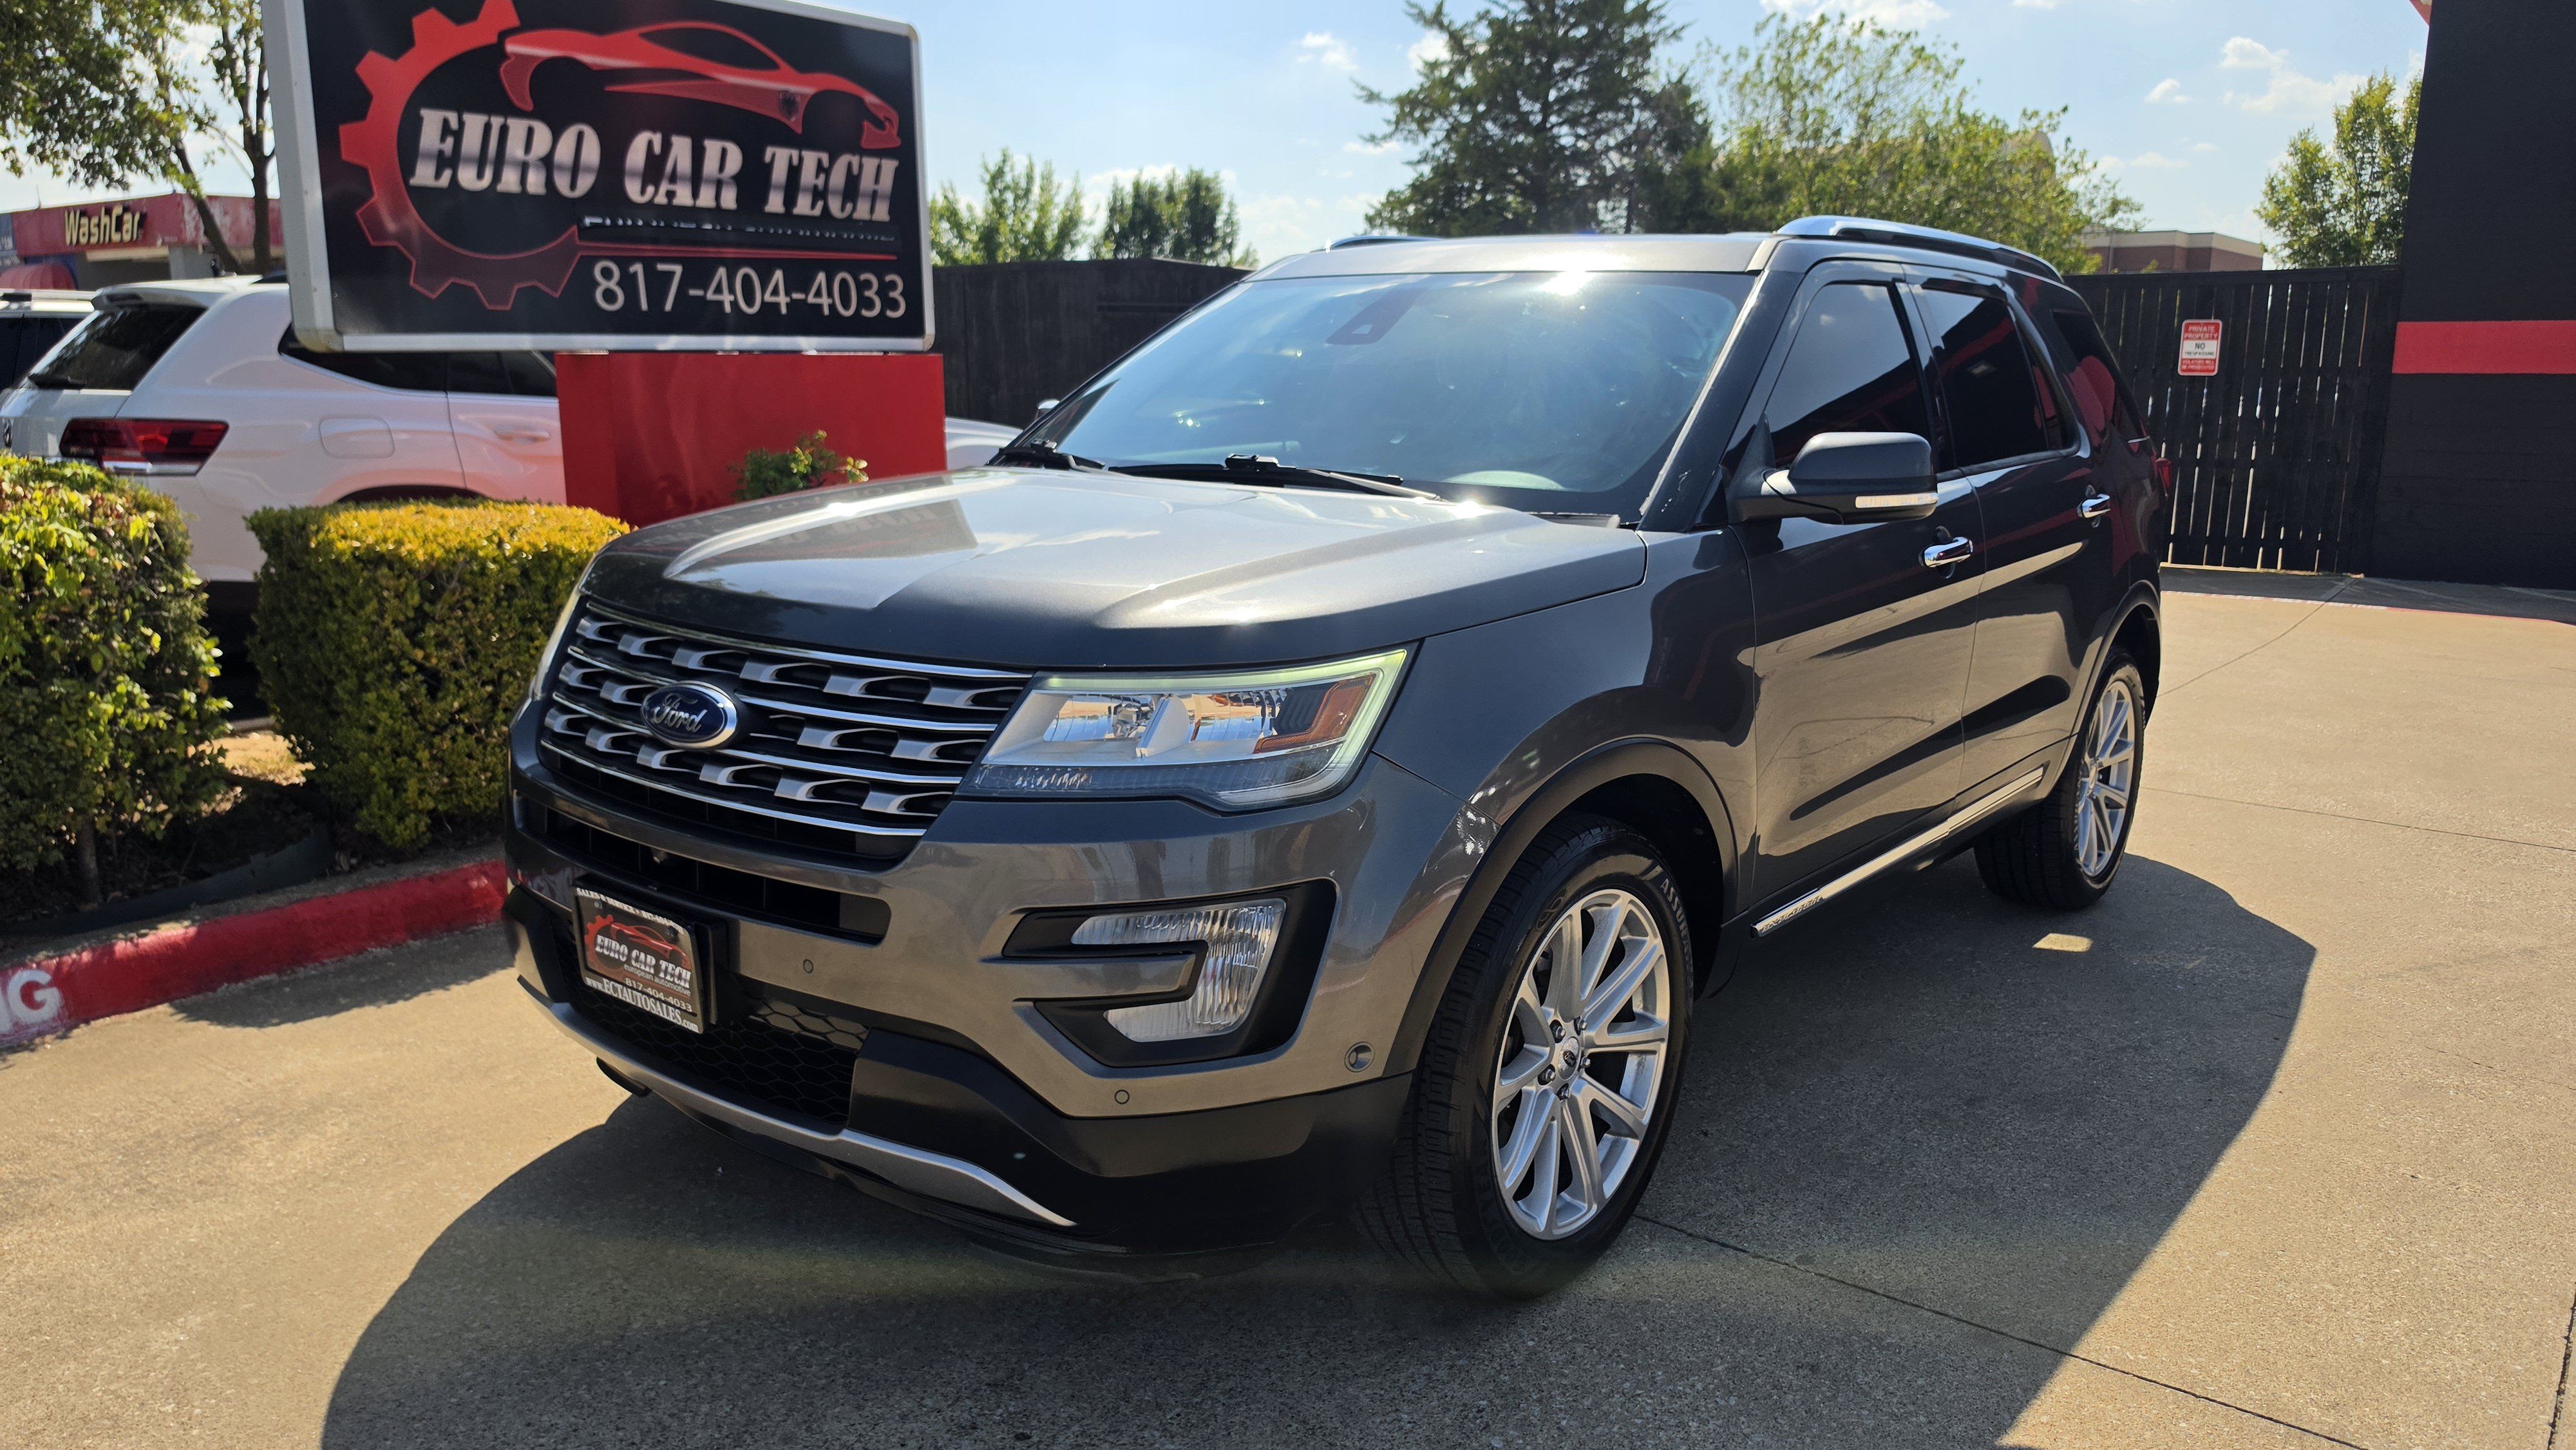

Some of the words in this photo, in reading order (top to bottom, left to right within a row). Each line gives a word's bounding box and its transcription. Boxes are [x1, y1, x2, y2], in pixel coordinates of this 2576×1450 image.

[410, 108, 601, 198] EURO
[625, 130, 743, 211] CAR
[764, 146, 900, 222] TECH
[64, 204, 140, 247] WashCar
[593, 260, 907, 319] 817-404-4033
[2195, 342, 2206, 350] NO
[651, 693, 708, 733] Ford
[595, 934, 629, 963] EURO
[631, 948, 656, 974] CAR
[658, 959, 692, 989] TECH
[624, 963, 654, 981] european
[654, 975, 691, 997] automotive
[585, 976, 699, 1033] www.ECTAUTOSALES.com
[625, 977, 693, 1013] 817-404-4033
